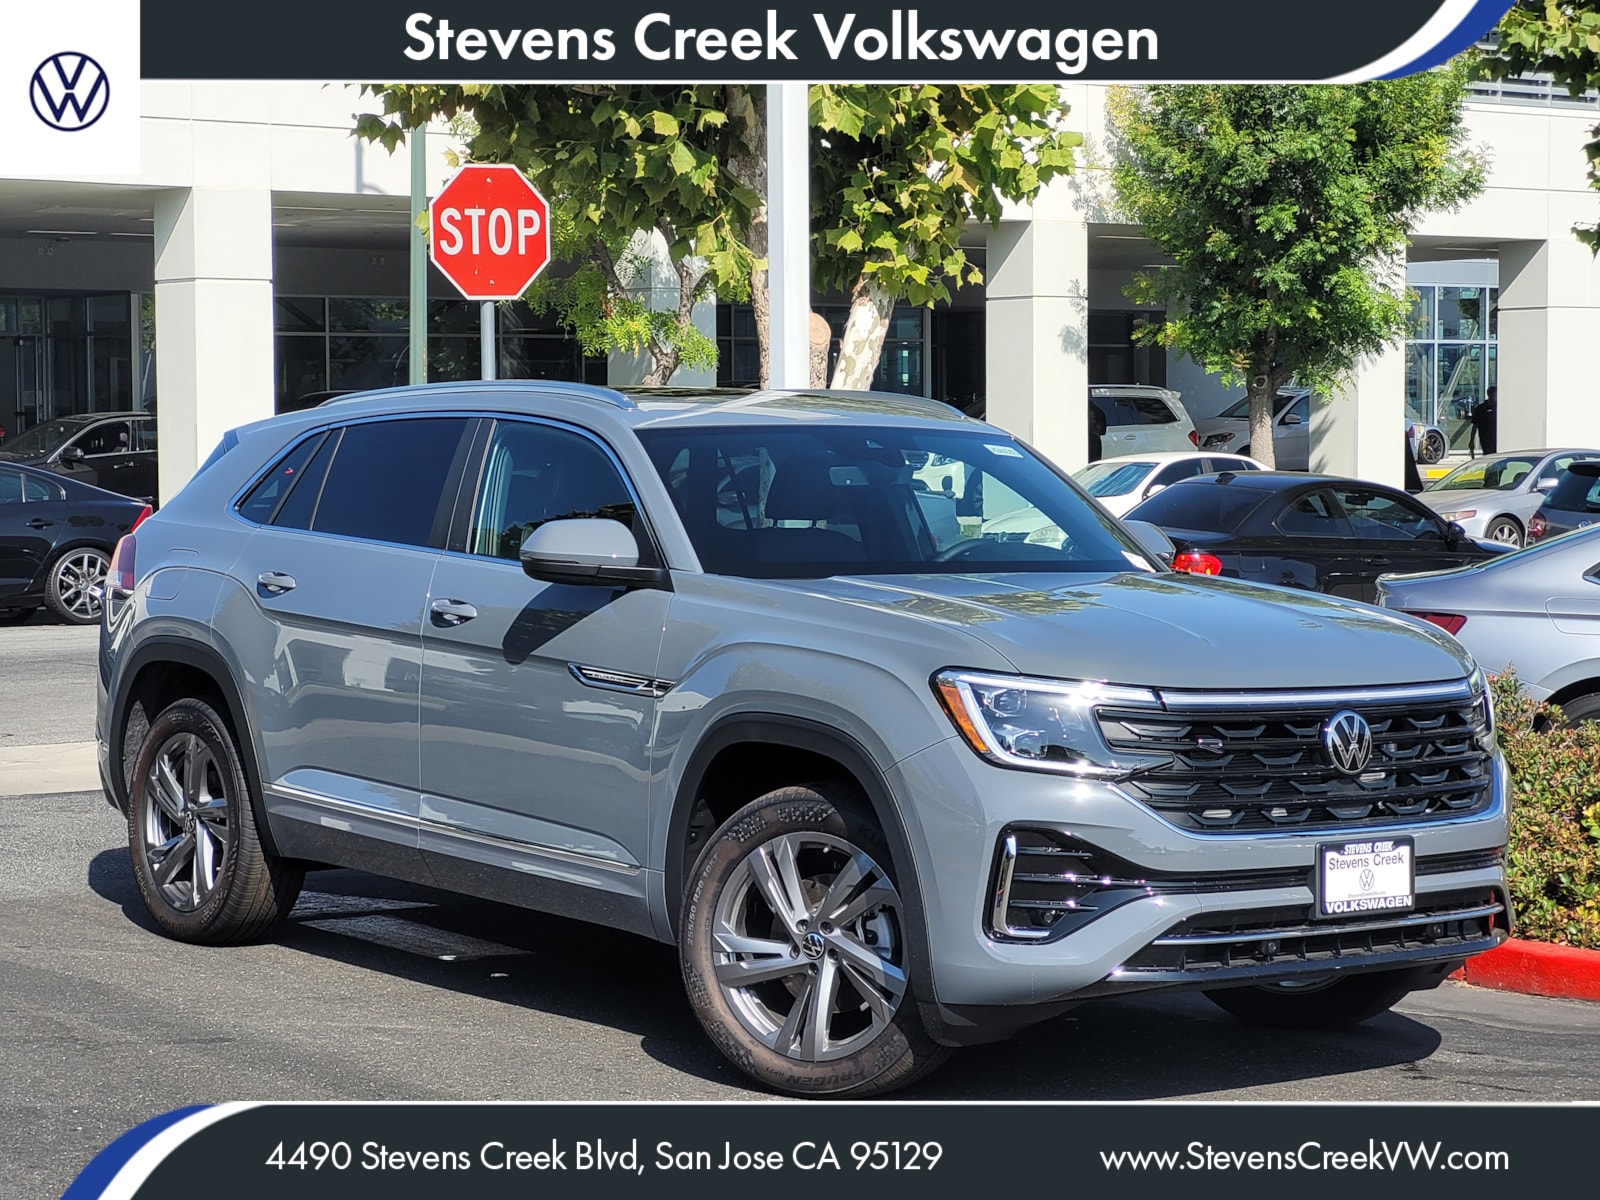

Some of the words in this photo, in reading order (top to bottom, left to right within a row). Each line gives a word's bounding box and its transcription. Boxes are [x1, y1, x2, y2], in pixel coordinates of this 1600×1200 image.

[440, 207, 541, 256] STOP
[1344, 843, 1373, 855] STEVENS
[1373, 841, 1394, 852] CREEK
[1329, 857, 1369, 870] Stevens
[1373, 852, 1405, 866] Creek
[693, 880, 705, 904] R20
[1326, 895, 1412, 913] VOLKSWAGEN
